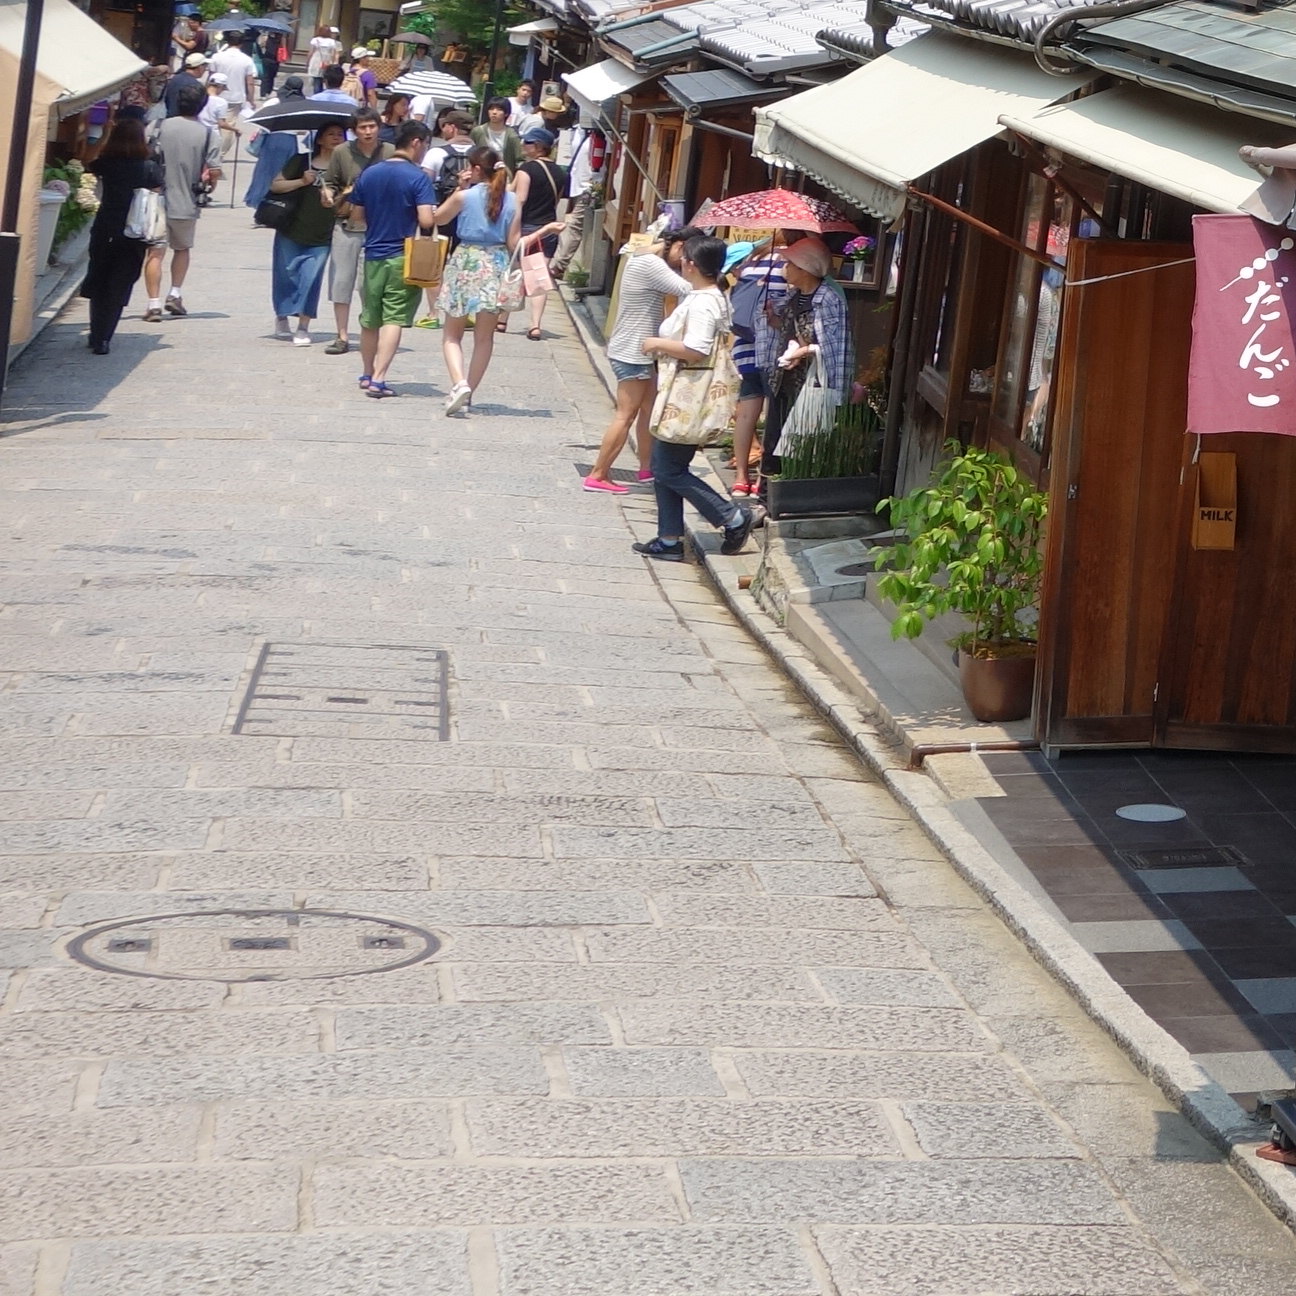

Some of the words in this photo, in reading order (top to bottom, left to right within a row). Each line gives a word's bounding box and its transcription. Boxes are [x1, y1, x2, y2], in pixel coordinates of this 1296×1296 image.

[1238, 275, 1290, 408] だんご
[1200, 509, 1234, 523] MILK
